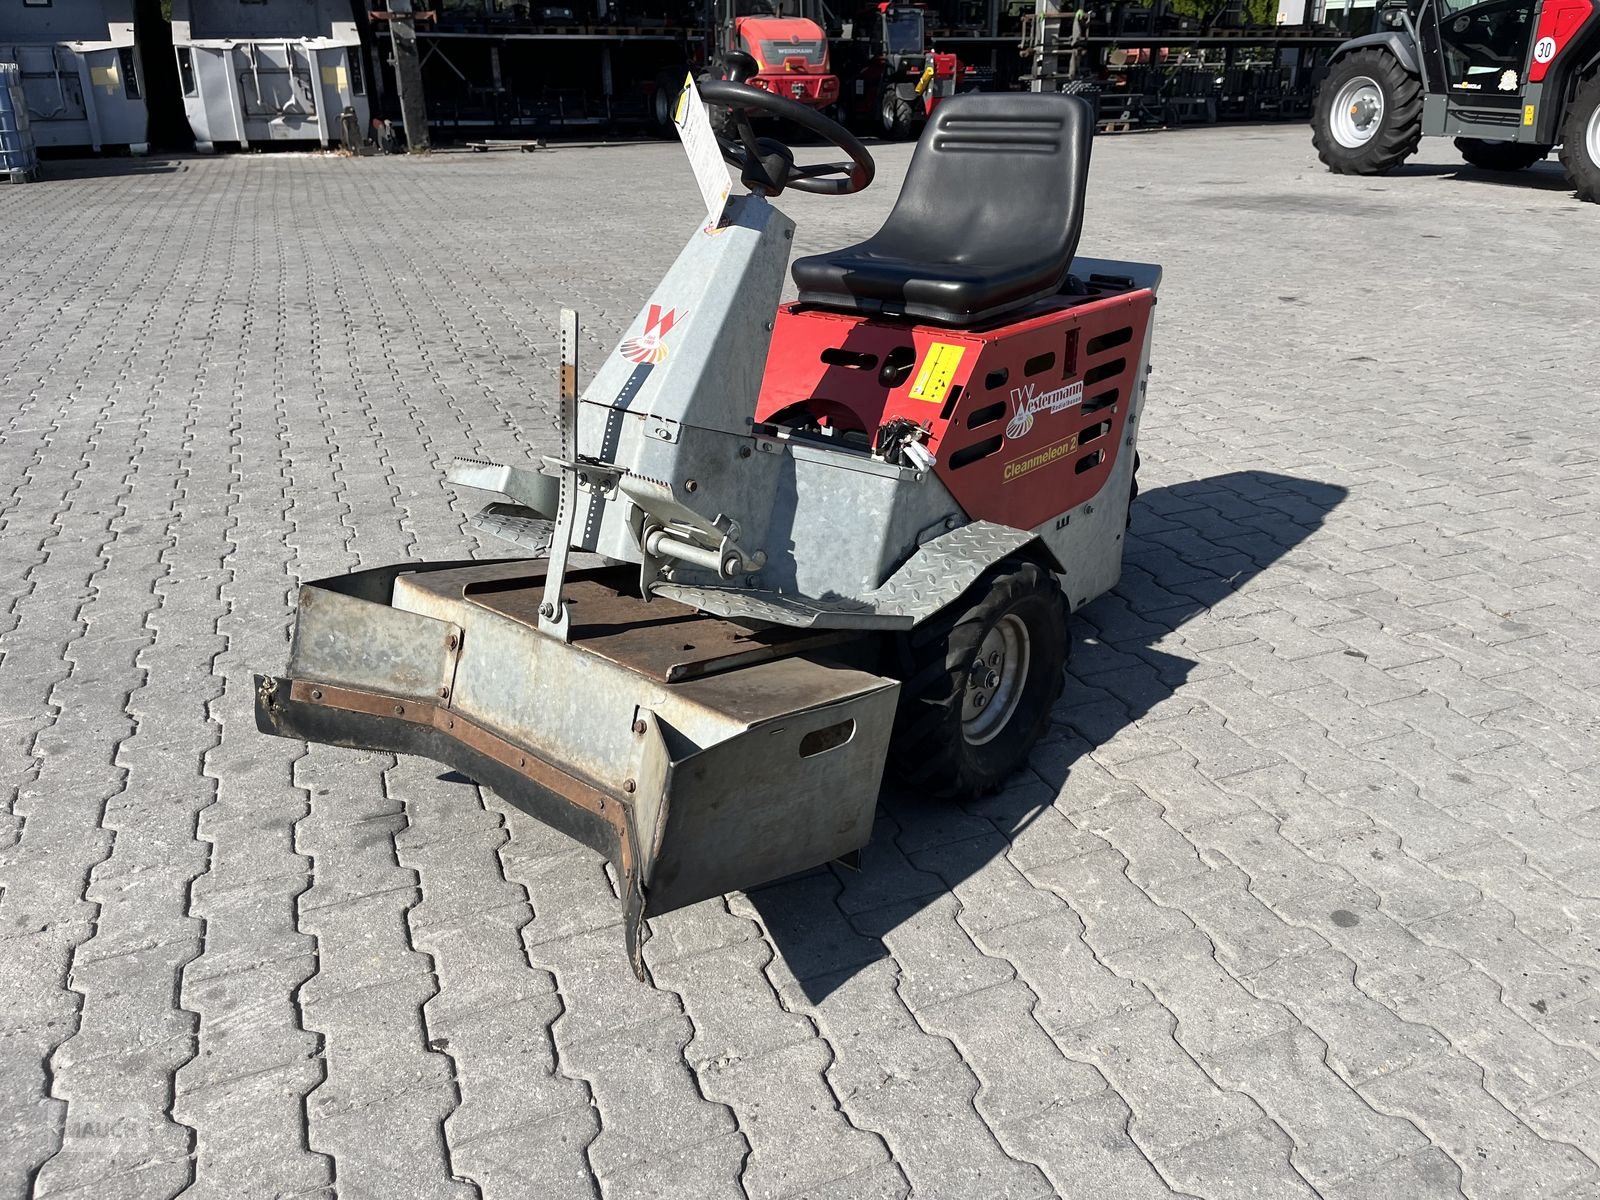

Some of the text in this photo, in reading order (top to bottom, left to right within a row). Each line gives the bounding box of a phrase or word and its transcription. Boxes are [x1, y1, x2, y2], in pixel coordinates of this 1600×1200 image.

[1537, 42, 1552, 58] 30
[1010, 383, 1083, 416] Westermann
[1004, 436, 1077, 479] Cleanmeleon 2
